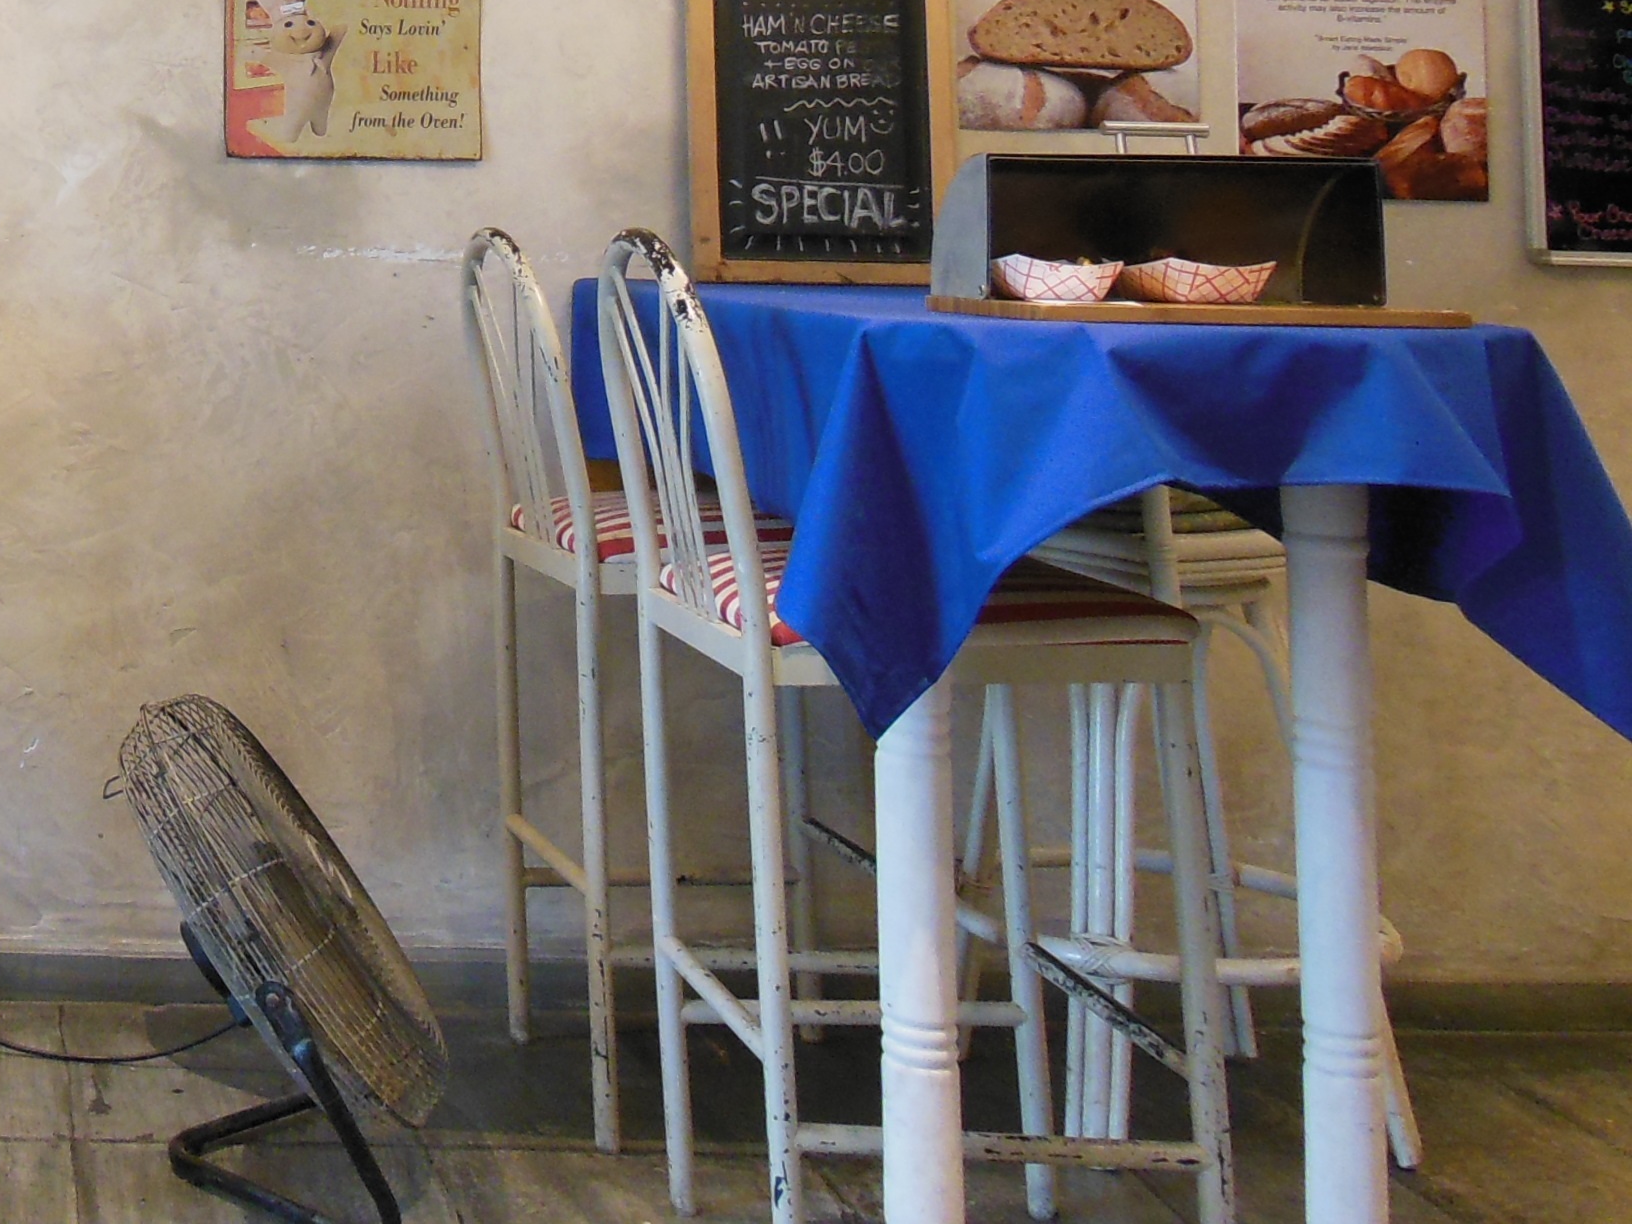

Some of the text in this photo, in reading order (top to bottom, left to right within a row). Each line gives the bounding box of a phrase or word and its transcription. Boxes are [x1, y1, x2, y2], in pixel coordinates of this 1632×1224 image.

[358, 18, 392, 40] Says
[742, 13, 787, 38] HAM
[753, 39, 830, 55] TOMATO
[371, 50, 418, 75] Like
[828, 57, 856, 70] ON
[751, 73, 831, 90] ARTISAN
[379, 84, 460, 108] Something
[348, 110, 465, 132] from the Oven!
[804, 115, 866, 146] YUM
[751, 182, 908, 231] SPECIAL
